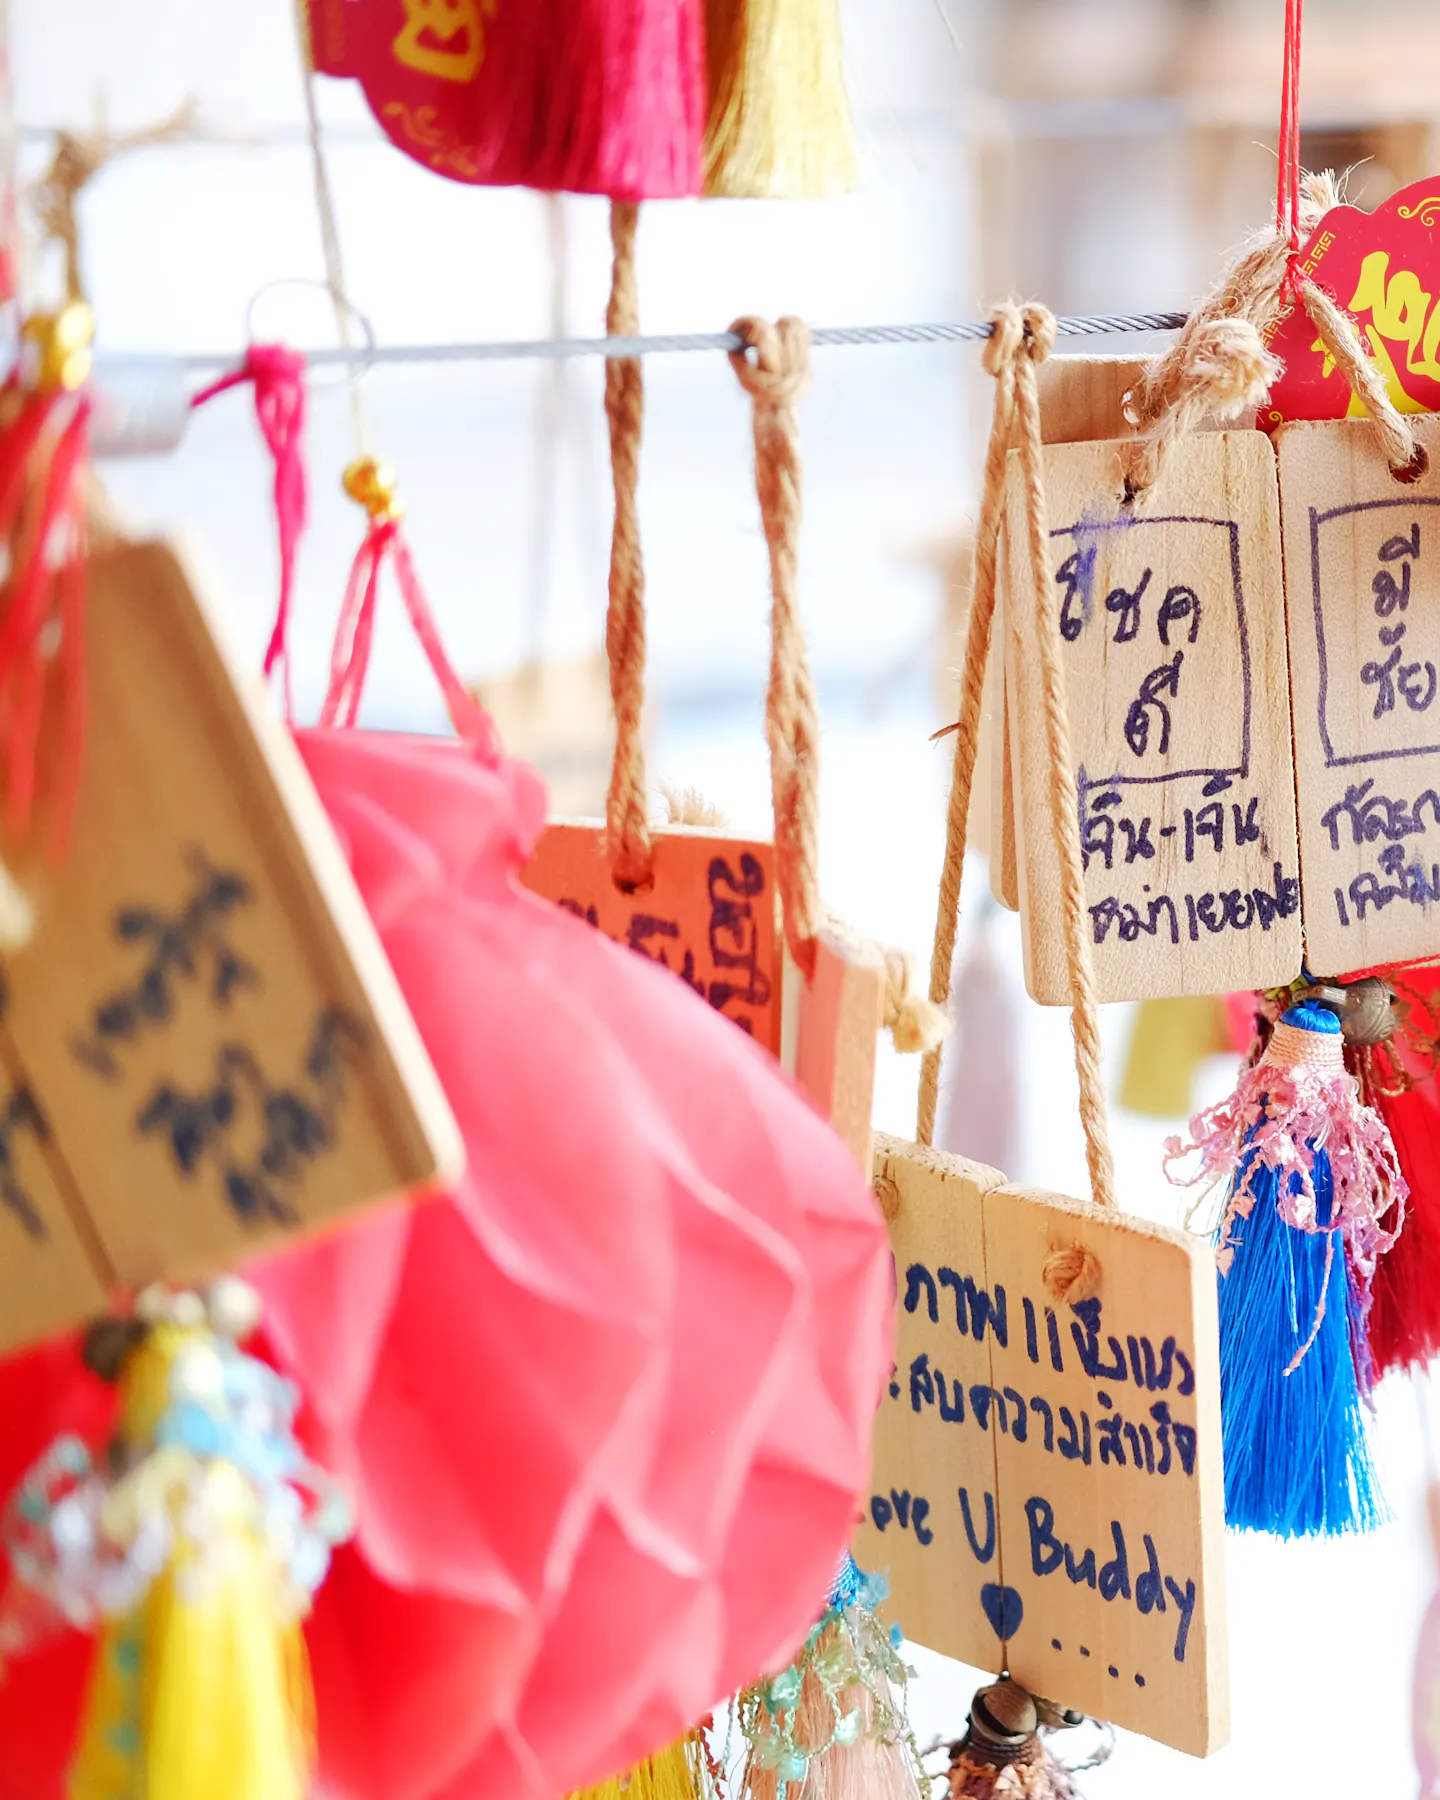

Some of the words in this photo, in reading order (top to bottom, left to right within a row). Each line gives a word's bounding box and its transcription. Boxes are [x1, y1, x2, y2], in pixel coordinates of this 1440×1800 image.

[1124, 650, 1184, 758] ดี
[890, 1251, 1197, 1397] ภาพแข็งแรง
[855, 1487, 934, 1547] ove
[958, 1487, 996, 1565] U
[1024, 1496, 1196, 1662] Buddy
